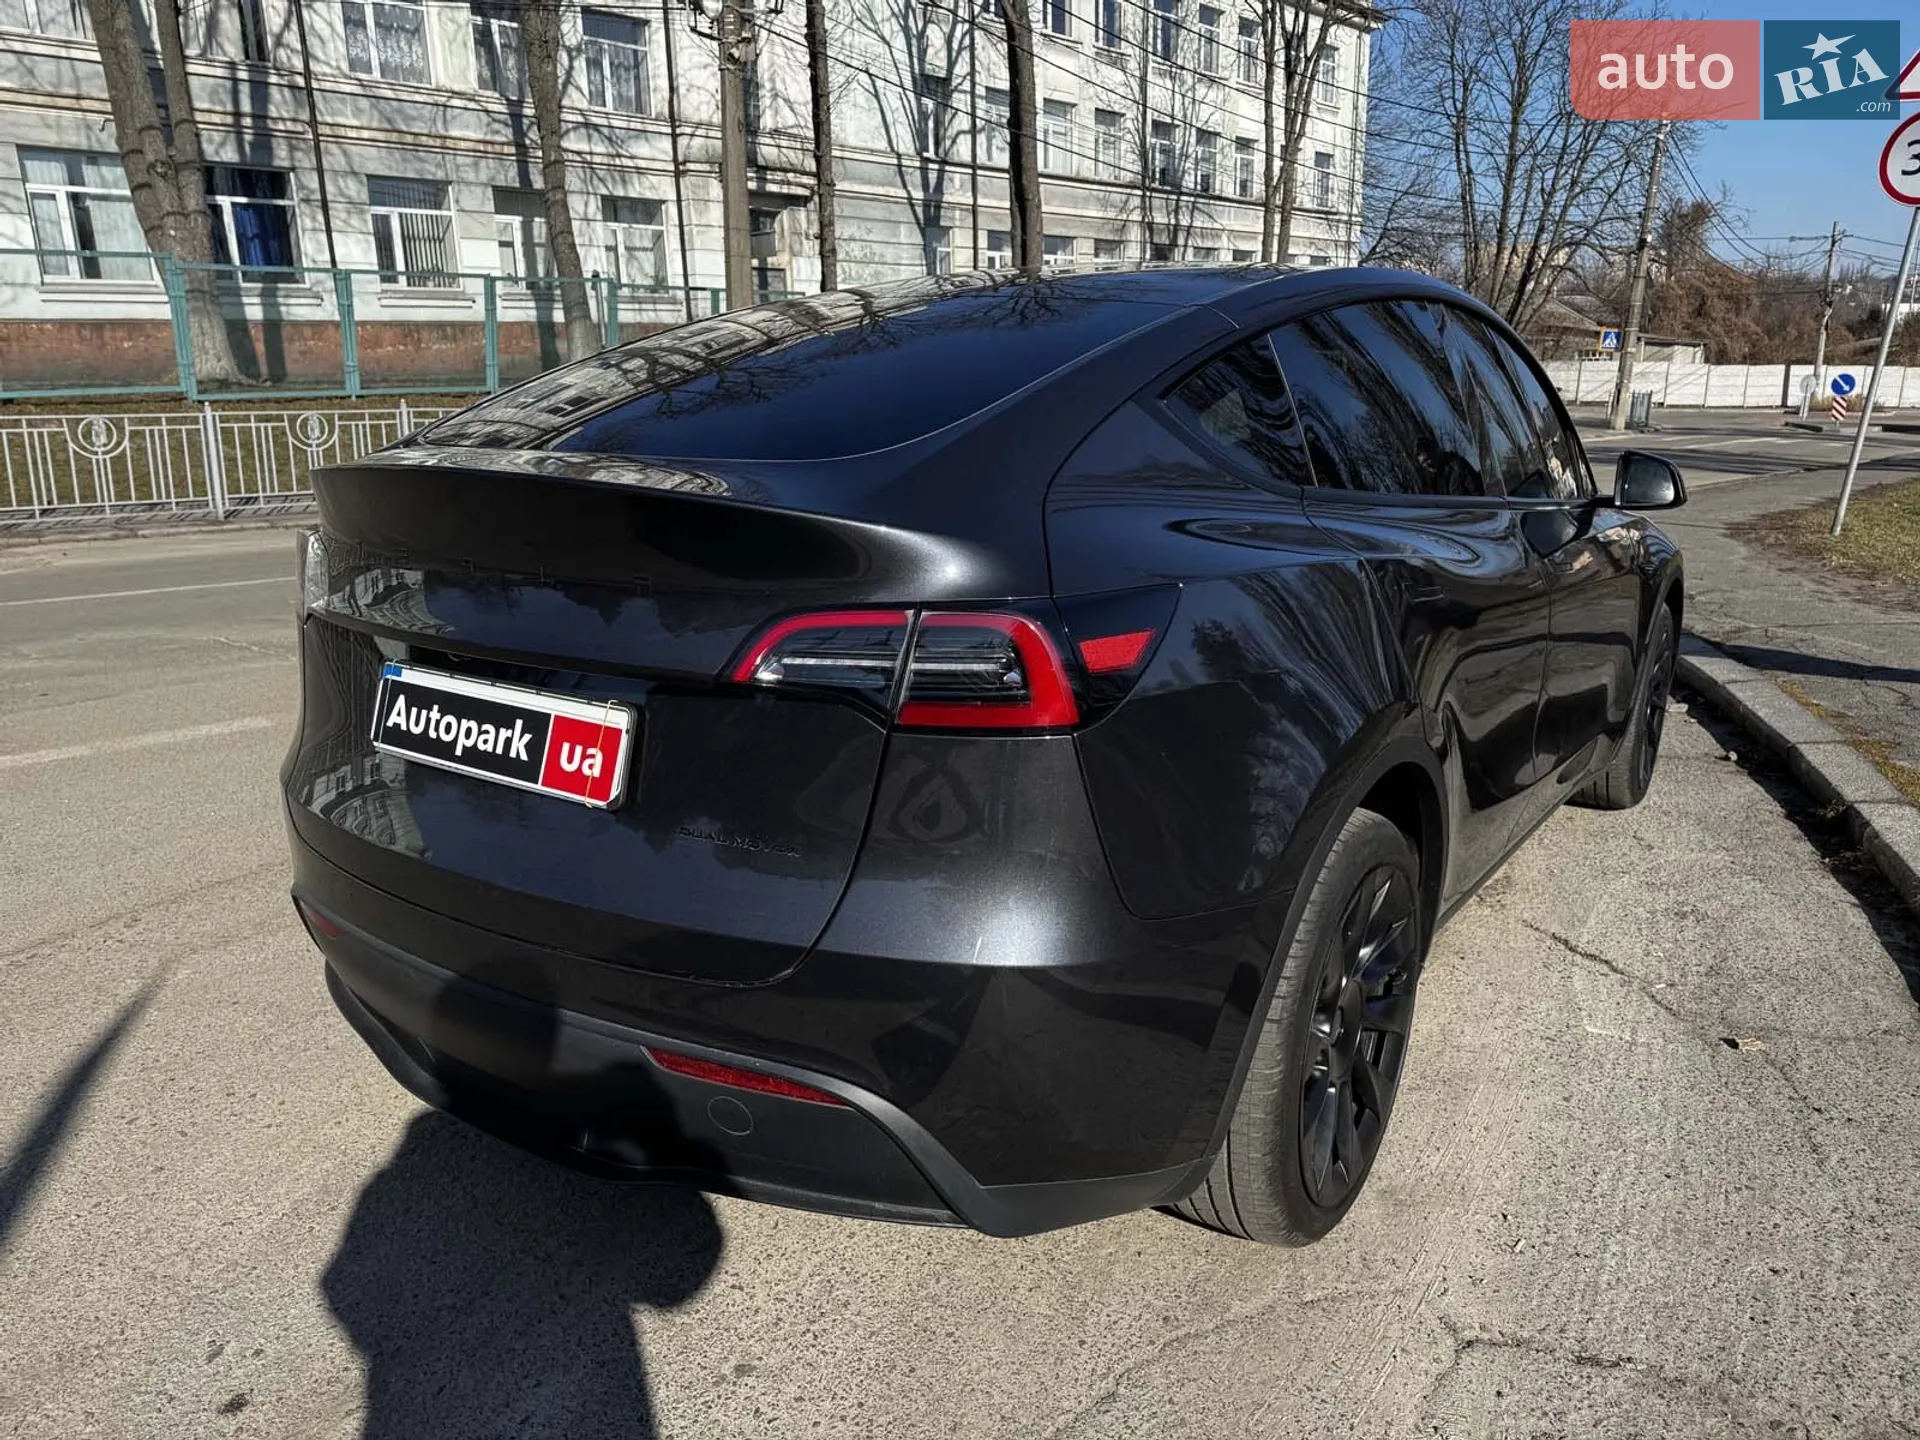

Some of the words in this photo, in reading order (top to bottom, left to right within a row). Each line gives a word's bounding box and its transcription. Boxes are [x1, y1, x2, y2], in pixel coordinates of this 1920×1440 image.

[386, 694, 532, 761] Autopark
[559, 741, 603, 778] ua
[679, 825, 729, 846] DUAL
